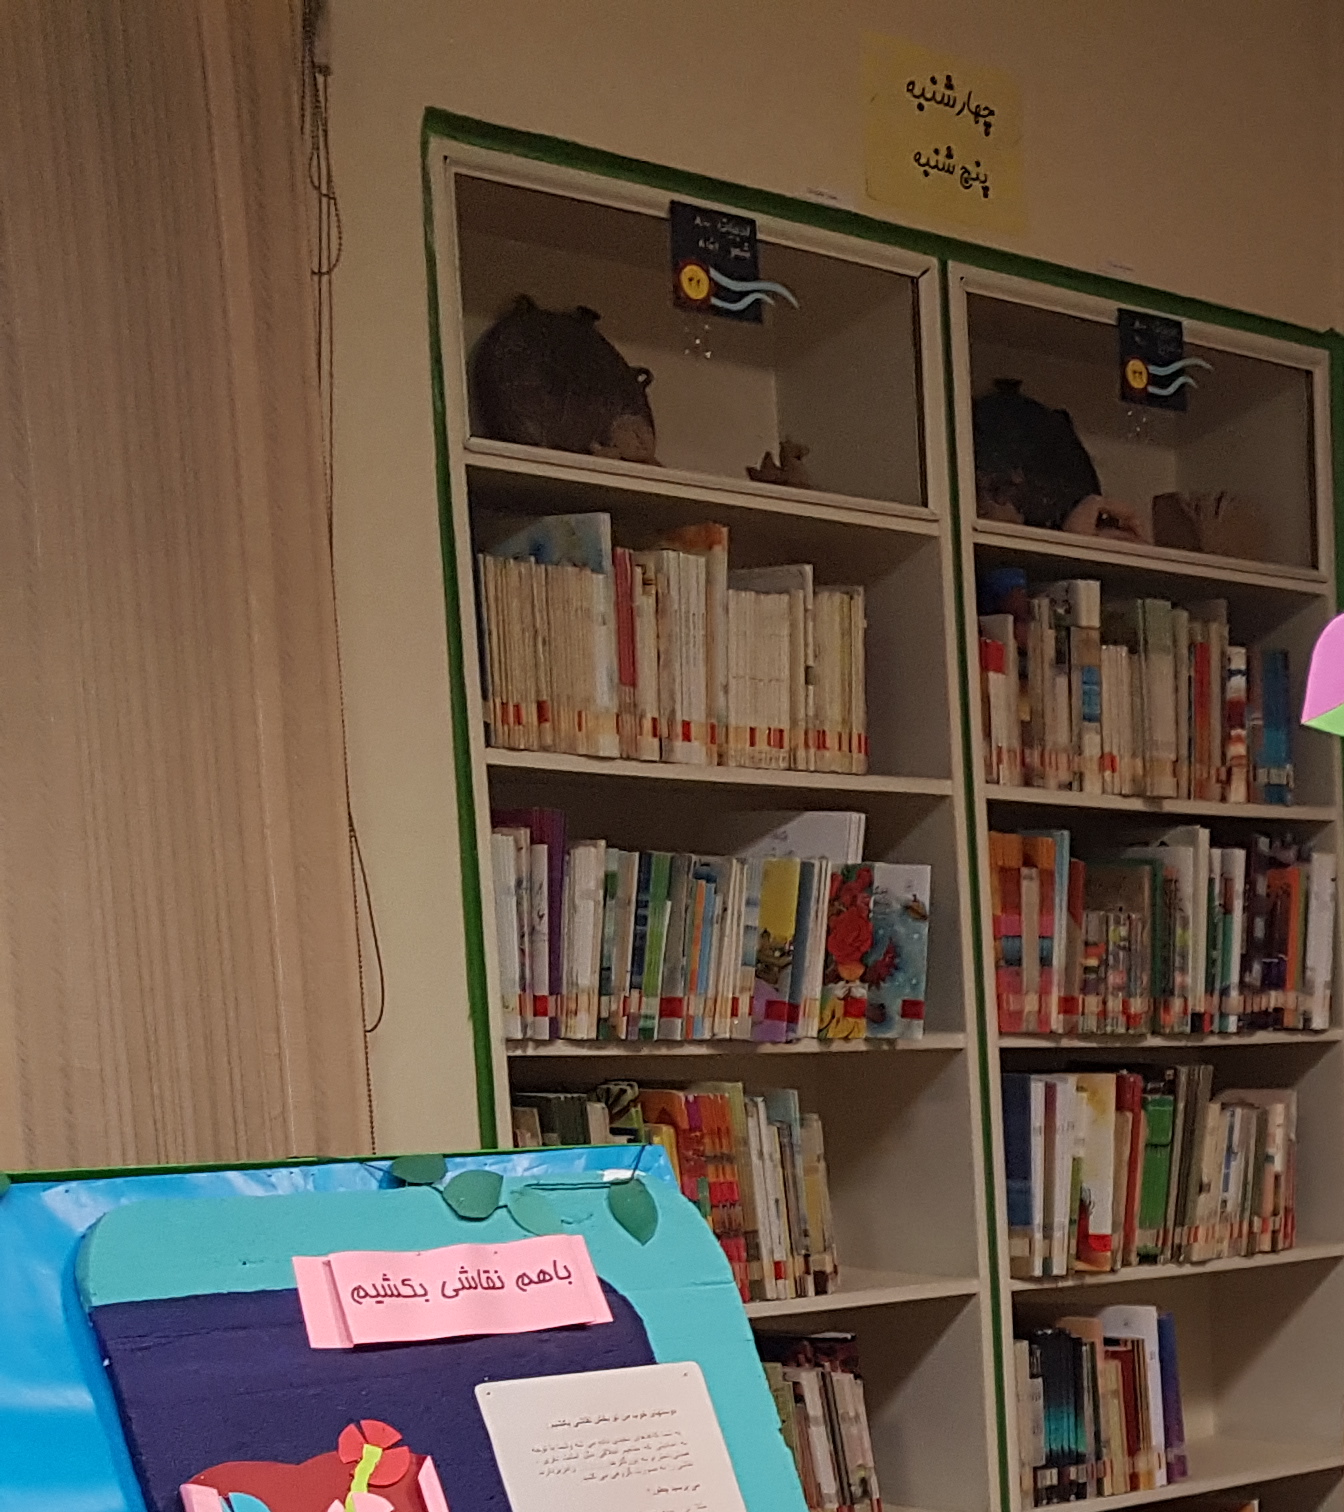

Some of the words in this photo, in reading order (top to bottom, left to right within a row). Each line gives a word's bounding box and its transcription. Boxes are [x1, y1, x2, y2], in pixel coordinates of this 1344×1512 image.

[906, 74, 996, 137] چهارشنبه
[913, 145, 956, 178] شنبه
[959, 160, 990, 199] پنج
[350, 1273, 430, 1305] بکشیم
[440, 1265, 506, 1299] نقاشی
[515, 1259, 573, 1292] باهم
